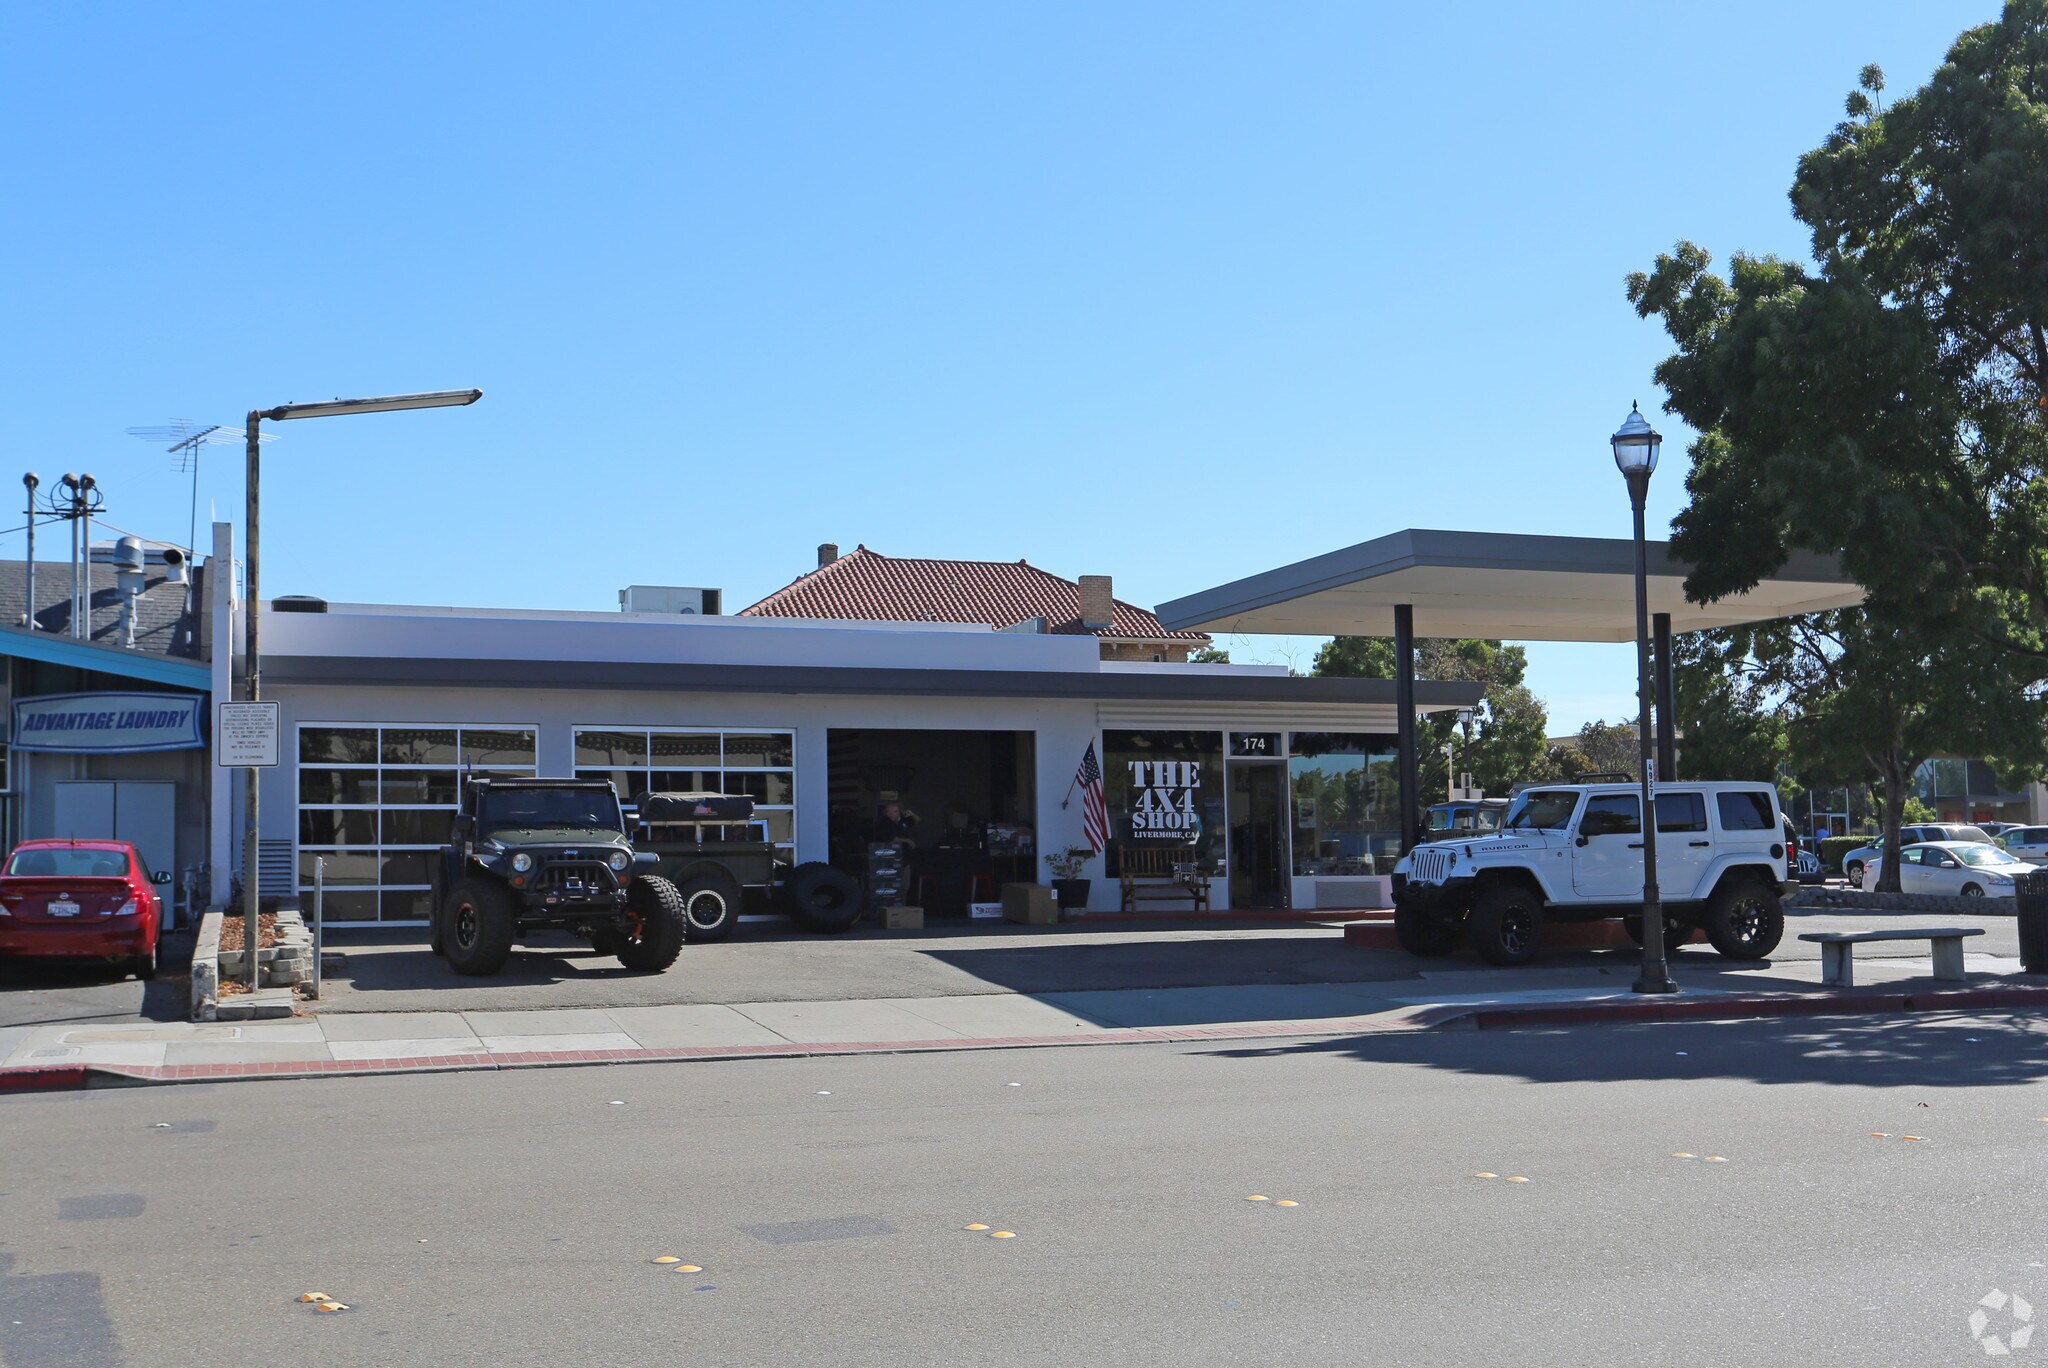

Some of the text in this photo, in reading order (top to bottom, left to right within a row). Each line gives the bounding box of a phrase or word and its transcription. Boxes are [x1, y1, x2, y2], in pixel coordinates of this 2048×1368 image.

[23, 710, 190, 731] ADVANTAGE LAUNDRY
[1243, 738, 1266, 750] 174
[1128, 760, 1200, 788] THE
[1135, 788, 1195, 812] 4X4
[1132, 812, 1198, 829] SHOP
